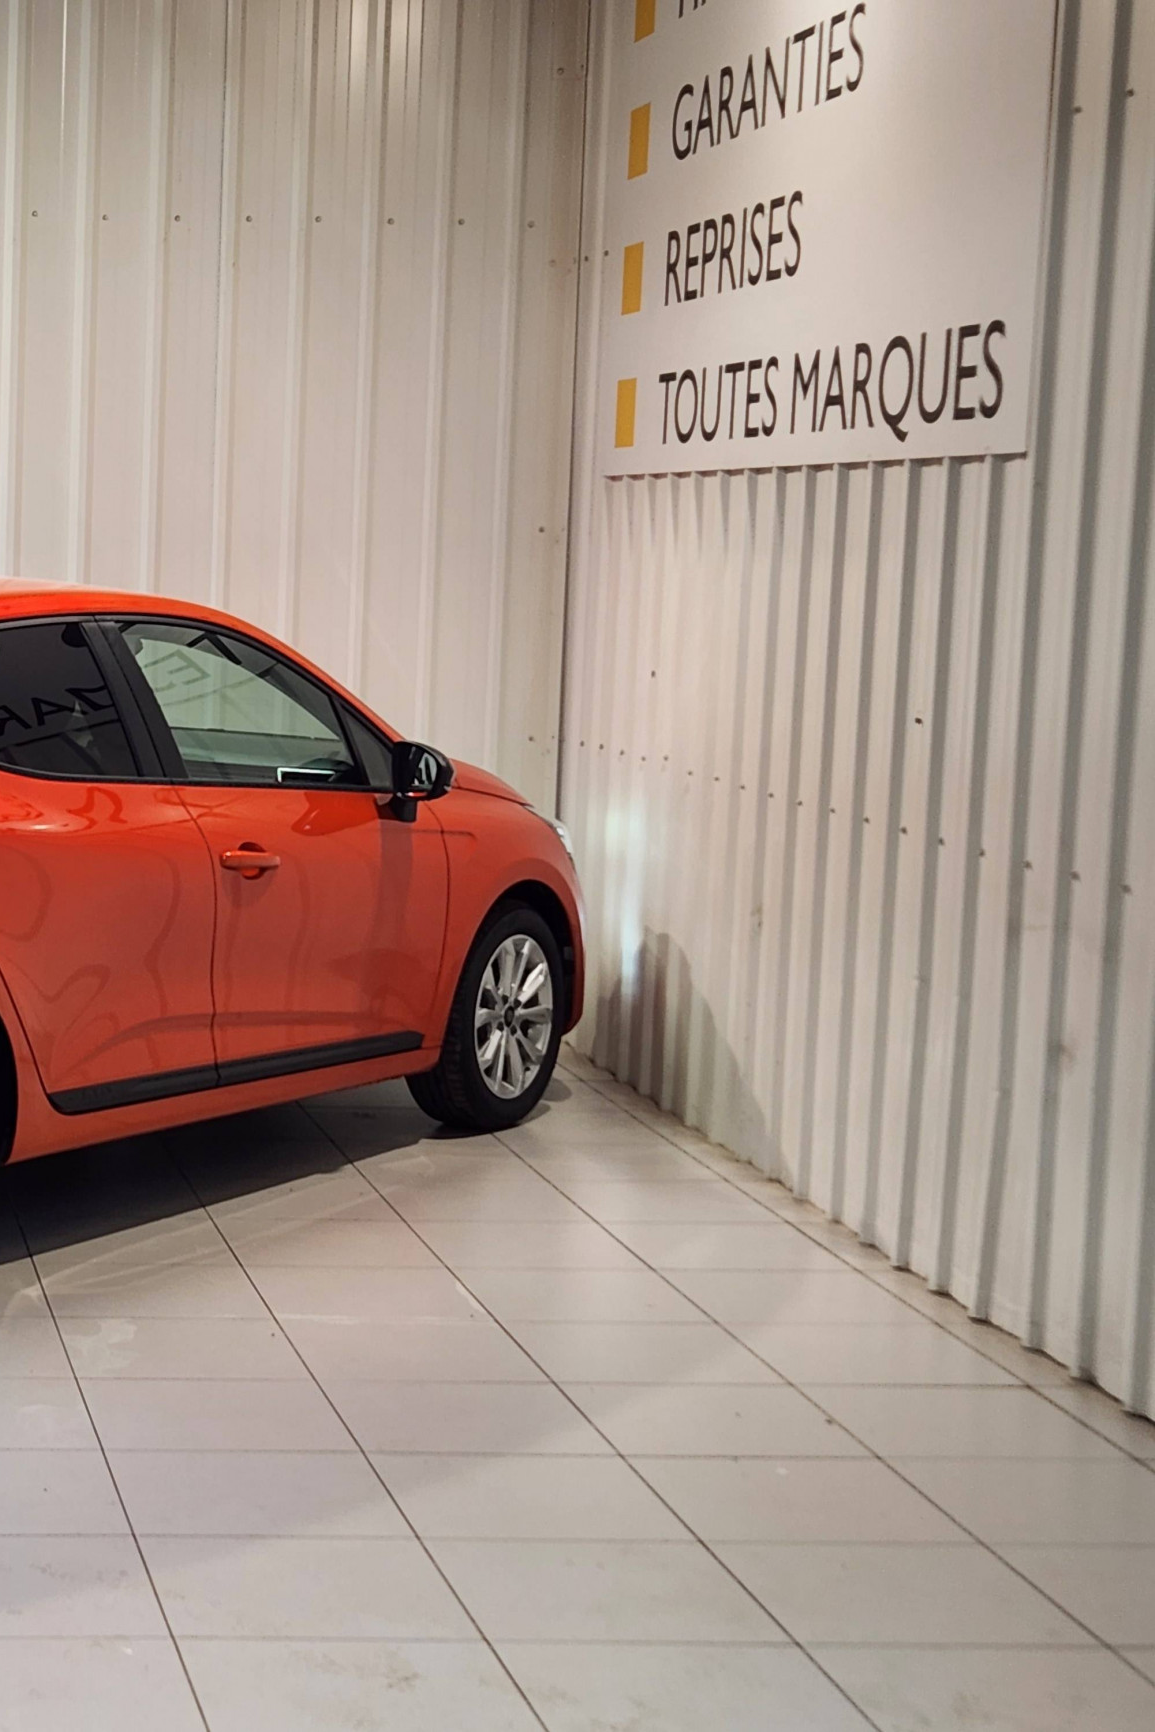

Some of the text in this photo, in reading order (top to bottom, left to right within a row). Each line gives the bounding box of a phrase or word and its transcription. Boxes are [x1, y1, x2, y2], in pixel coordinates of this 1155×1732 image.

[671, 3, 866, 161] GARANTIES
[664, 190, 804, 307] REPRISES
[658, 319, 1007, 445] TOUTES MARQUES
